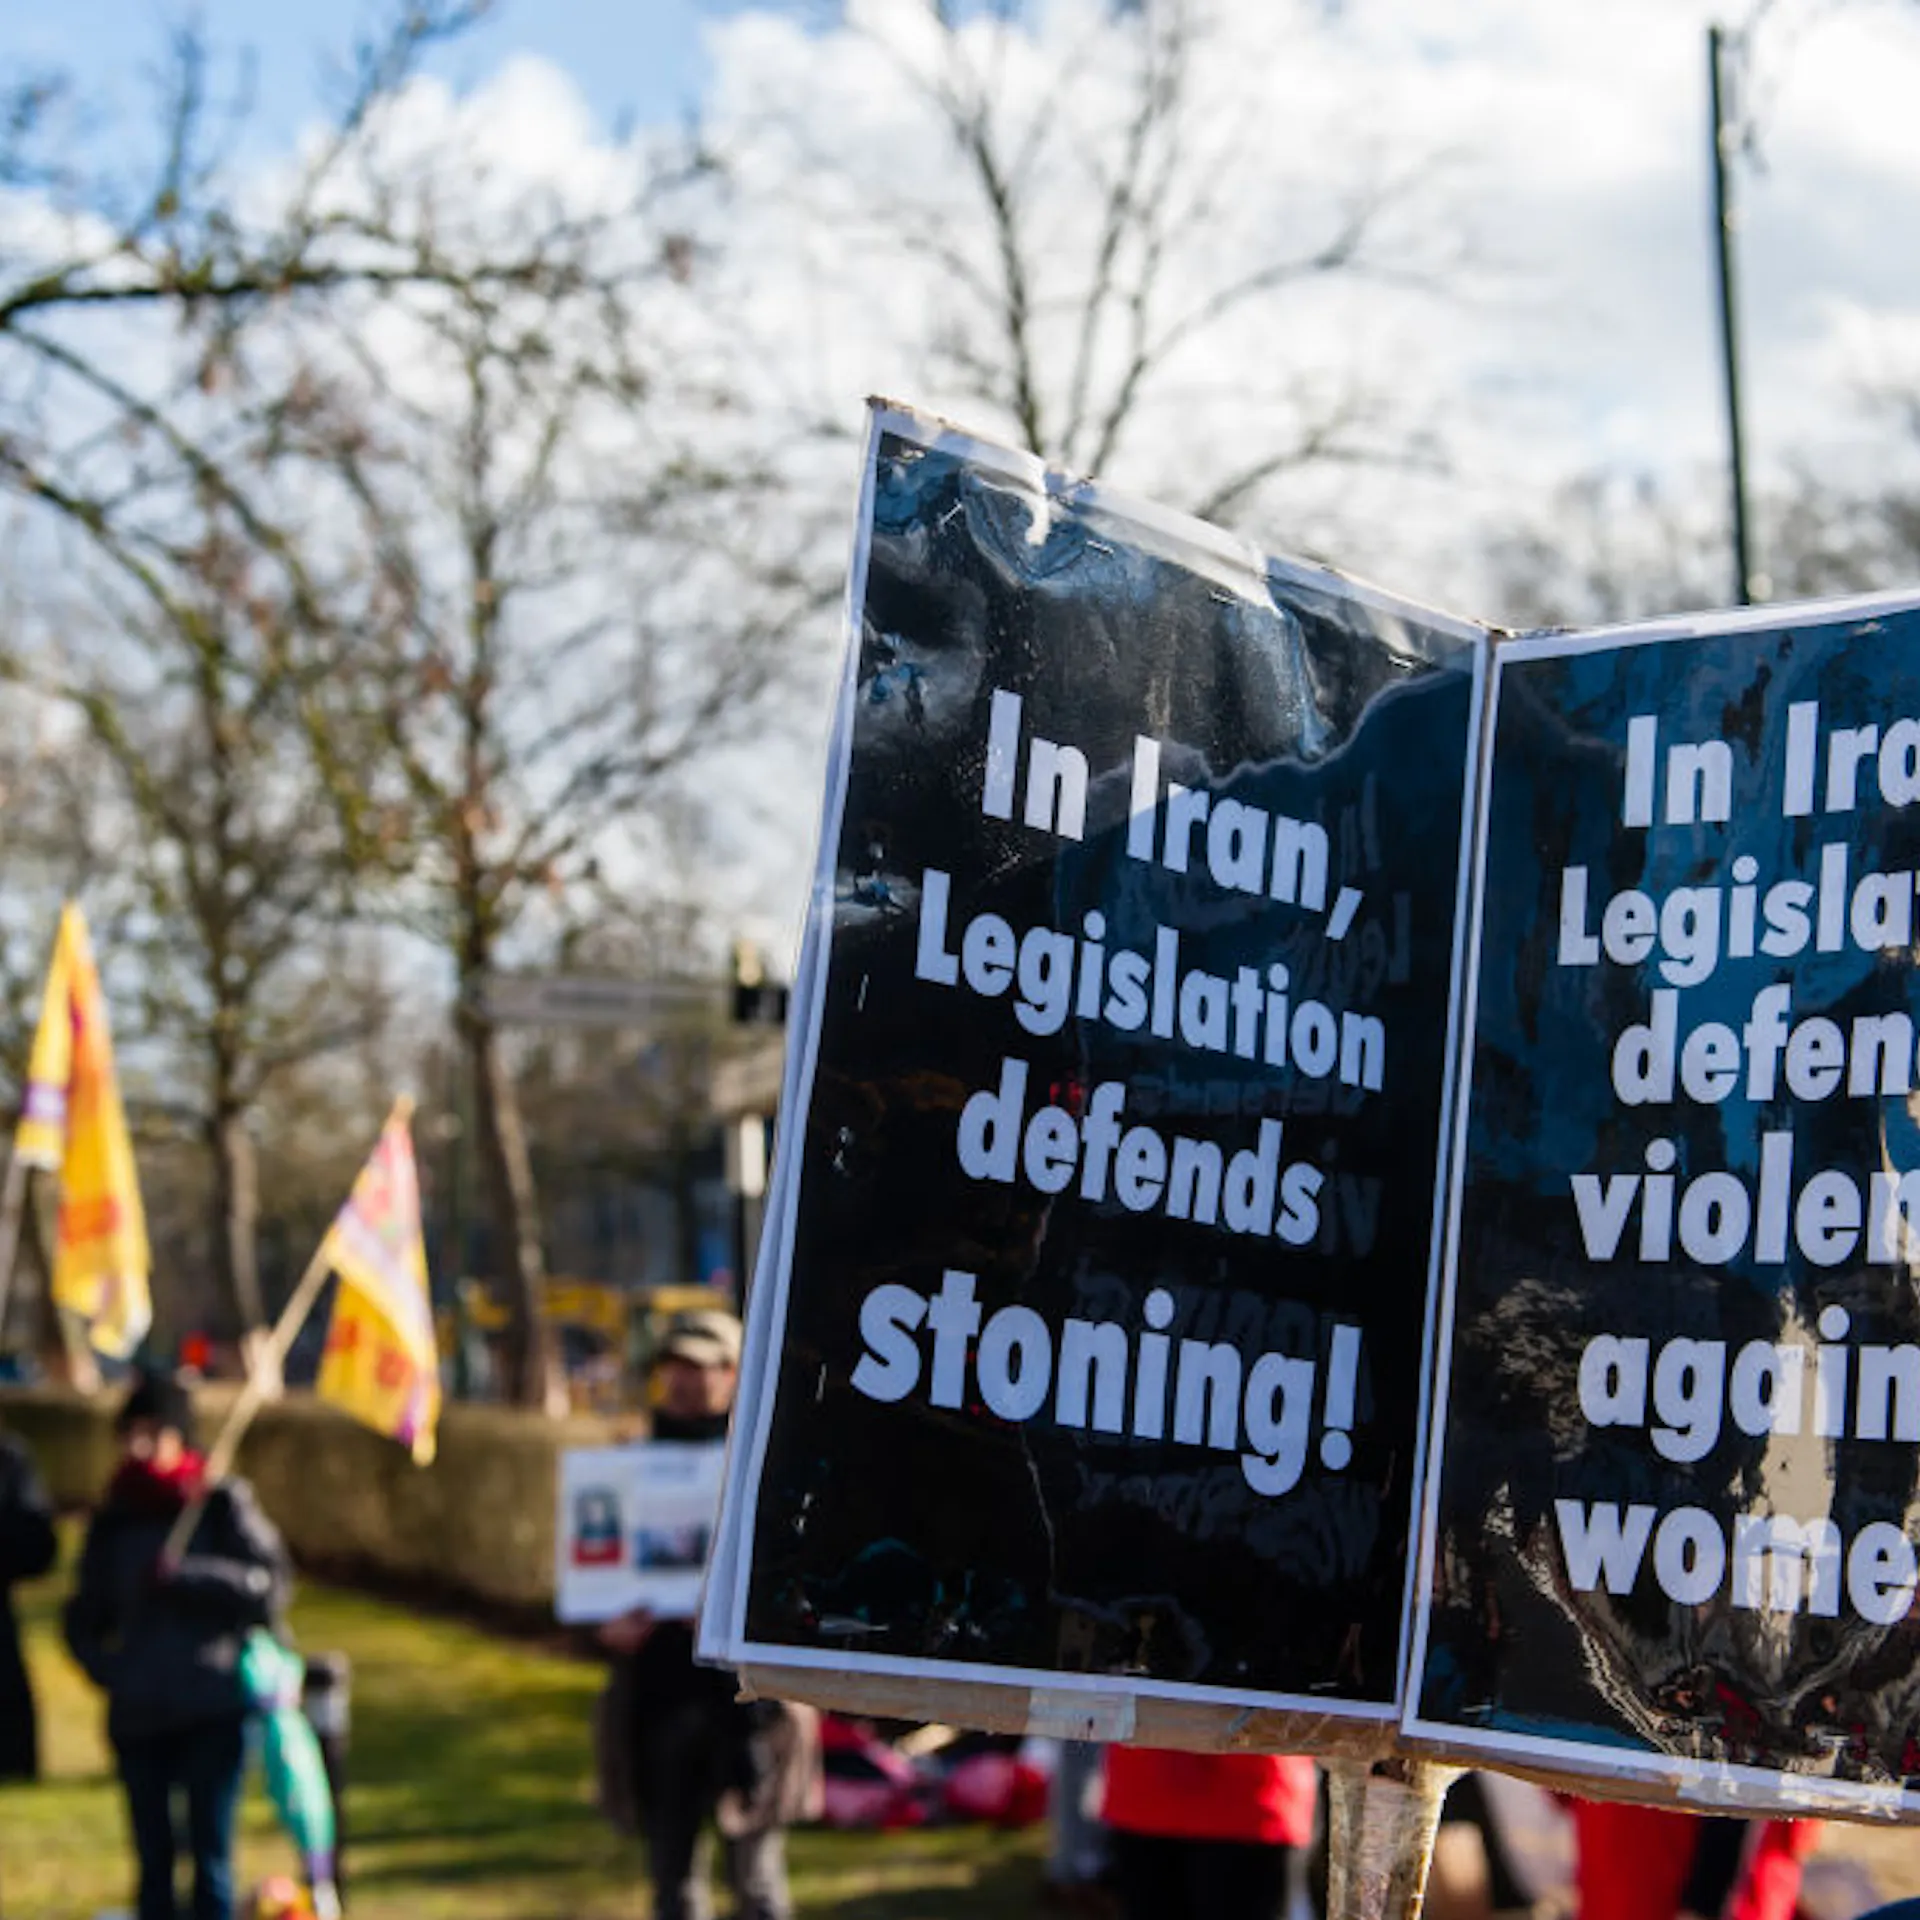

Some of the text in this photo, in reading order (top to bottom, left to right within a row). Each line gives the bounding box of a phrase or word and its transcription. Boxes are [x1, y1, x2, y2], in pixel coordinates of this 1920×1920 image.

[982, 687, 1363, 940] In Iran,
[1624, 715, 1733, 827] In
[915, 868, 1385, 1092] Legislation
[1558, 843, 1920, 987] Legisla
[1613, 984, 1920, 1106] defen
[957, 1057, 1324, 1245] defends
[1570, 1132, 1920, 1265] violen
[850, 1269, 1362, 1496] stoning!
[1577, 1305, 1920, 1463] again
[1555, 1498, 1918, 1625] wome
